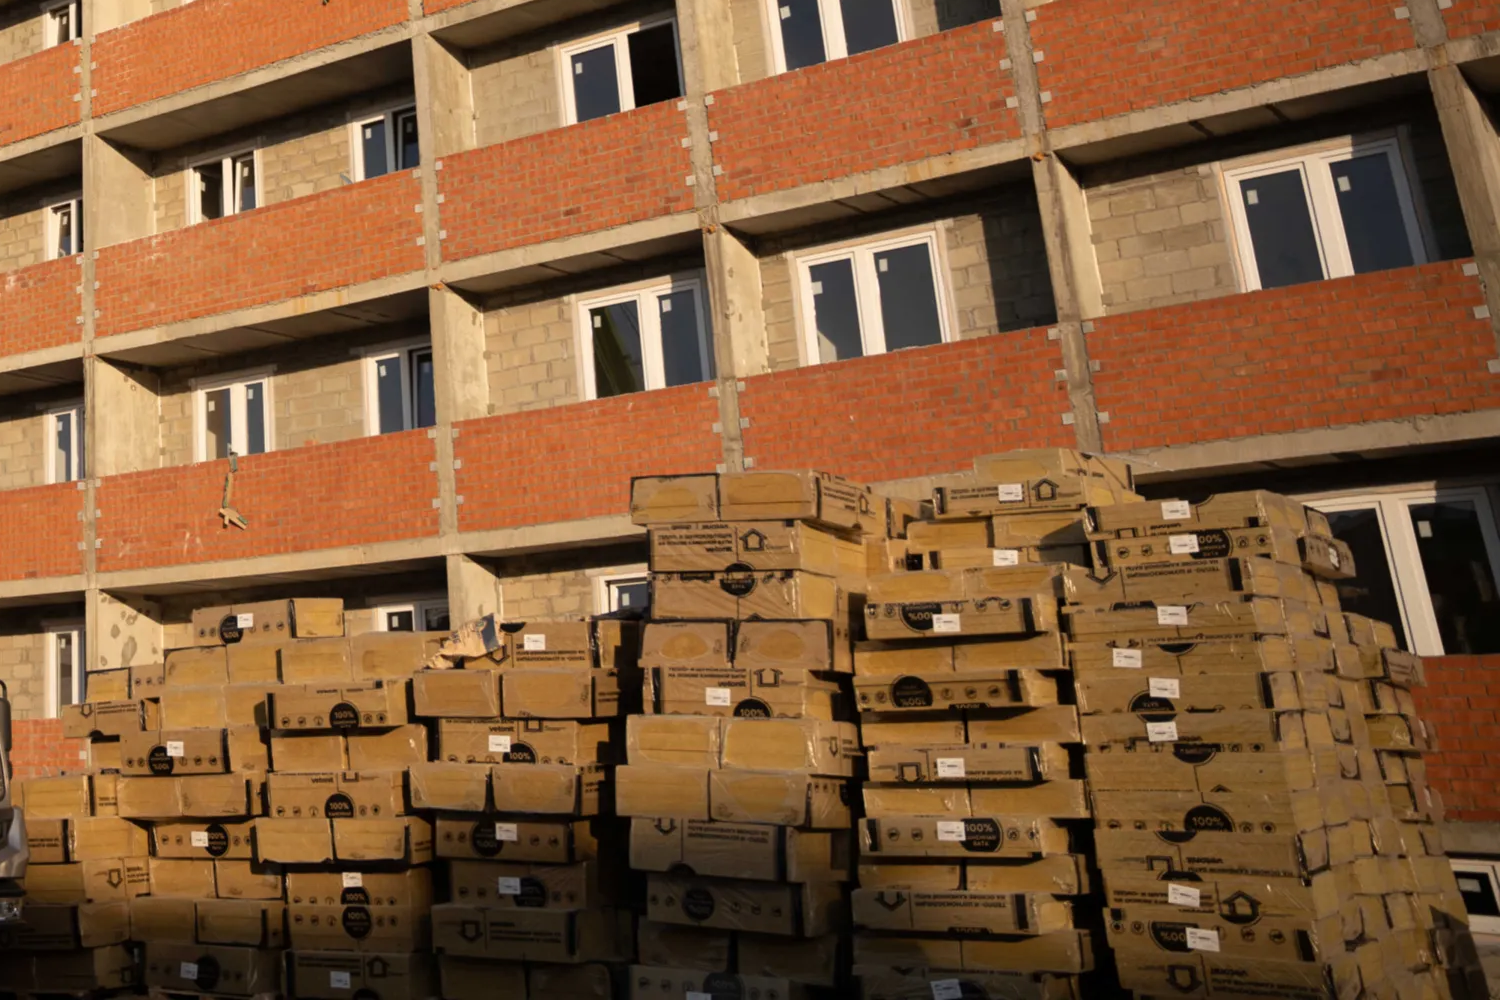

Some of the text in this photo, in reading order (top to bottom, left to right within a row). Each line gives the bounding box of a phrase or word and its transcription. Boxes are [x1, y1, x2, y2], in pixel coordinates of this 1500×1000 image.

[509, 752, 532, 760] 100%
[329, 802, 350, 810] 100%
[1192, 817, 1224, 828] 100%
[965, 824, 994, 832] 100%
[1160, 932, 1187, 941] 00%
